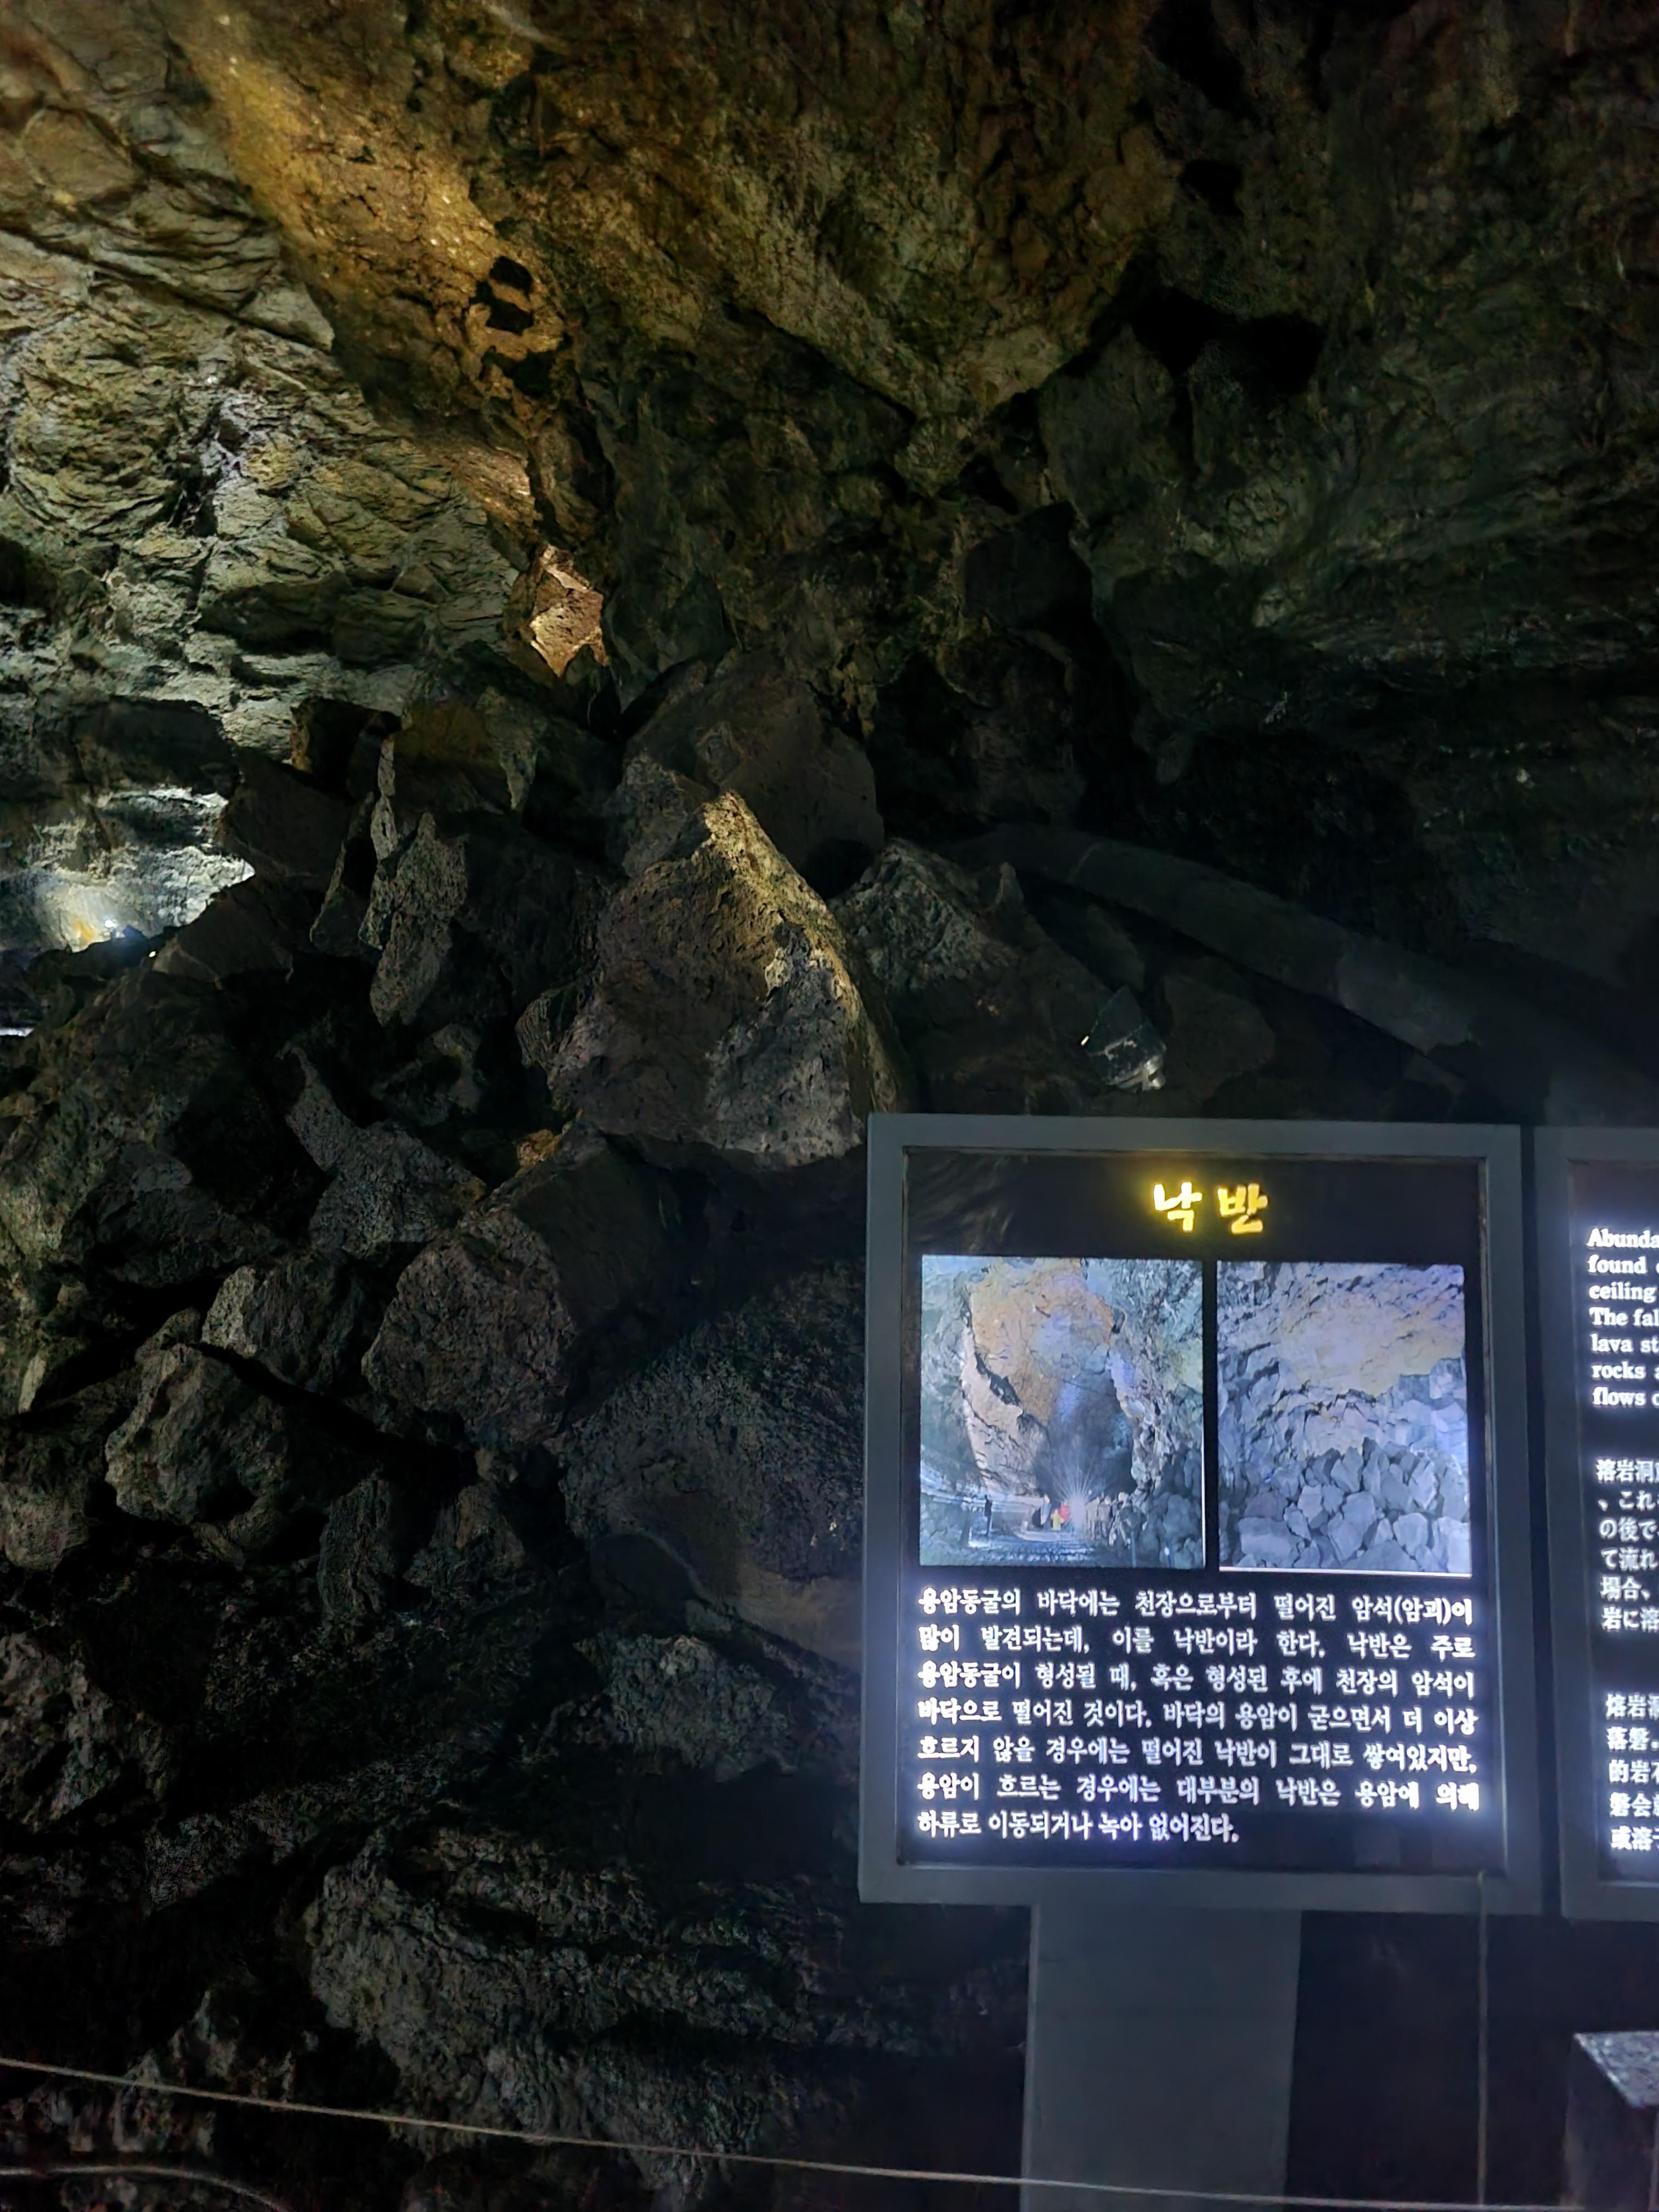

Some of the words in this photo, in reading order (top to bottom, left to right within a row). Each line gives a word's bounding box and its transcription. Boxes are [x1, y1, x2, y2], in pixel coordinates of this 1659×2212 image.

[1152, 1181, 1203, 1232] 낙
[1217, 1183, 1268, 1234] 반
[1587, 1254, 1647, 1274] found
[1589, 1282, 1657, 1304] ceiling
[1589, 1306, 1628, 1326] The
[1590, 1333, 1634, 1352] lava
[1591, 1361, 1646, 1379] rocks
[1592, 1386, 1646, 1406] flows
[1595, 1459, 1659, 1483] 溶岩洞
[1598, 1490, 1659, 1511] 、これ
[918, 1587, 1020, 1615] 용암동굴의
[1036, 1588, 1120, 1617] 바닥에는
[1135, 1590, 1256, 1620] 천장으로부터
[1273, 1593, 1336, 1621] 떨어진
[1352, 1595, 1472, 1626] 암석(암괴)이
[918, 1623, 960, 1651] 많이
[980, 1624, 1090, 1654] 발견되는데,
[1112, 1626, 1154, 1654] 이를
[1173, 1627, 1258, 1656] 낙반이라
[1276, 1629, 1325, 1658] 한다.
[1347, 1631, 1412, 1659] 낙반은
[1430, 1635, 1476, 1661] 주로
[917, 1660, 1020, 1689] 용암동굴이
[1035, 1662, 1096, 1689] 형성될
[1109, 1663, 1137, 1691] 때,
[1150, 1663, 1194, 1691] 혹은
[1205, 1664, 1268, 1692] 형성된
[1280, 1666, 1322, 1695] 후에
[1336, 1668, 1398, 1697] 천장의
[1412, 1670, 1474, 1700] 암석이
[917, 1697, 1002, 1725] 바닥으로
[1012, 1699, 1073, 1726] 떨어진
[1084, 1699, 1152, 1728] 것이다.
[1163, 1700, 1225, 1729] 바닥의
[1235, 1702, 1297, 1731] 용암이
[1307, 1705, 1391, 1734] 굳으면서
[1402, 1707, 1422, 1734] 더
[1434, 1707, 1479, 1735] 이상
[917, 1735, 979, 1763] 흐르지
[993, 1735, 1035, 1763] 않을
[1046, 1736, 1130, 1764] 경우에는
[1141, 1737, 1204, 1766] 떨어진
[1214, 1738, 1277, 1768] 낙반이
[1289, 1740, 1354, 1769] 그대로
[1363, 1743, 1477, 1774] 쌓여있지만,
[917, 1772, 979, 1801] 용암이
[996, 1774, 1061, 1800] 흐르는
[1076, 1774, 1161, 1803] 경우에는
[1176, 1775, 1259, 1805] 대부분의
[1276, 1777, 1341, 1806] 낙반은
[1355, 1780, 1419, 1809] 용암에
[1436, 1781, 1480, 1811] 의해
[917, 1809, 981, 1838] 하류로
[989, 1810, 1093, 1840] 이동되거나
[1098, 1812, 1143, 1841] 녹아
[1149, 1812, 1239, 1843] 없어진다.
